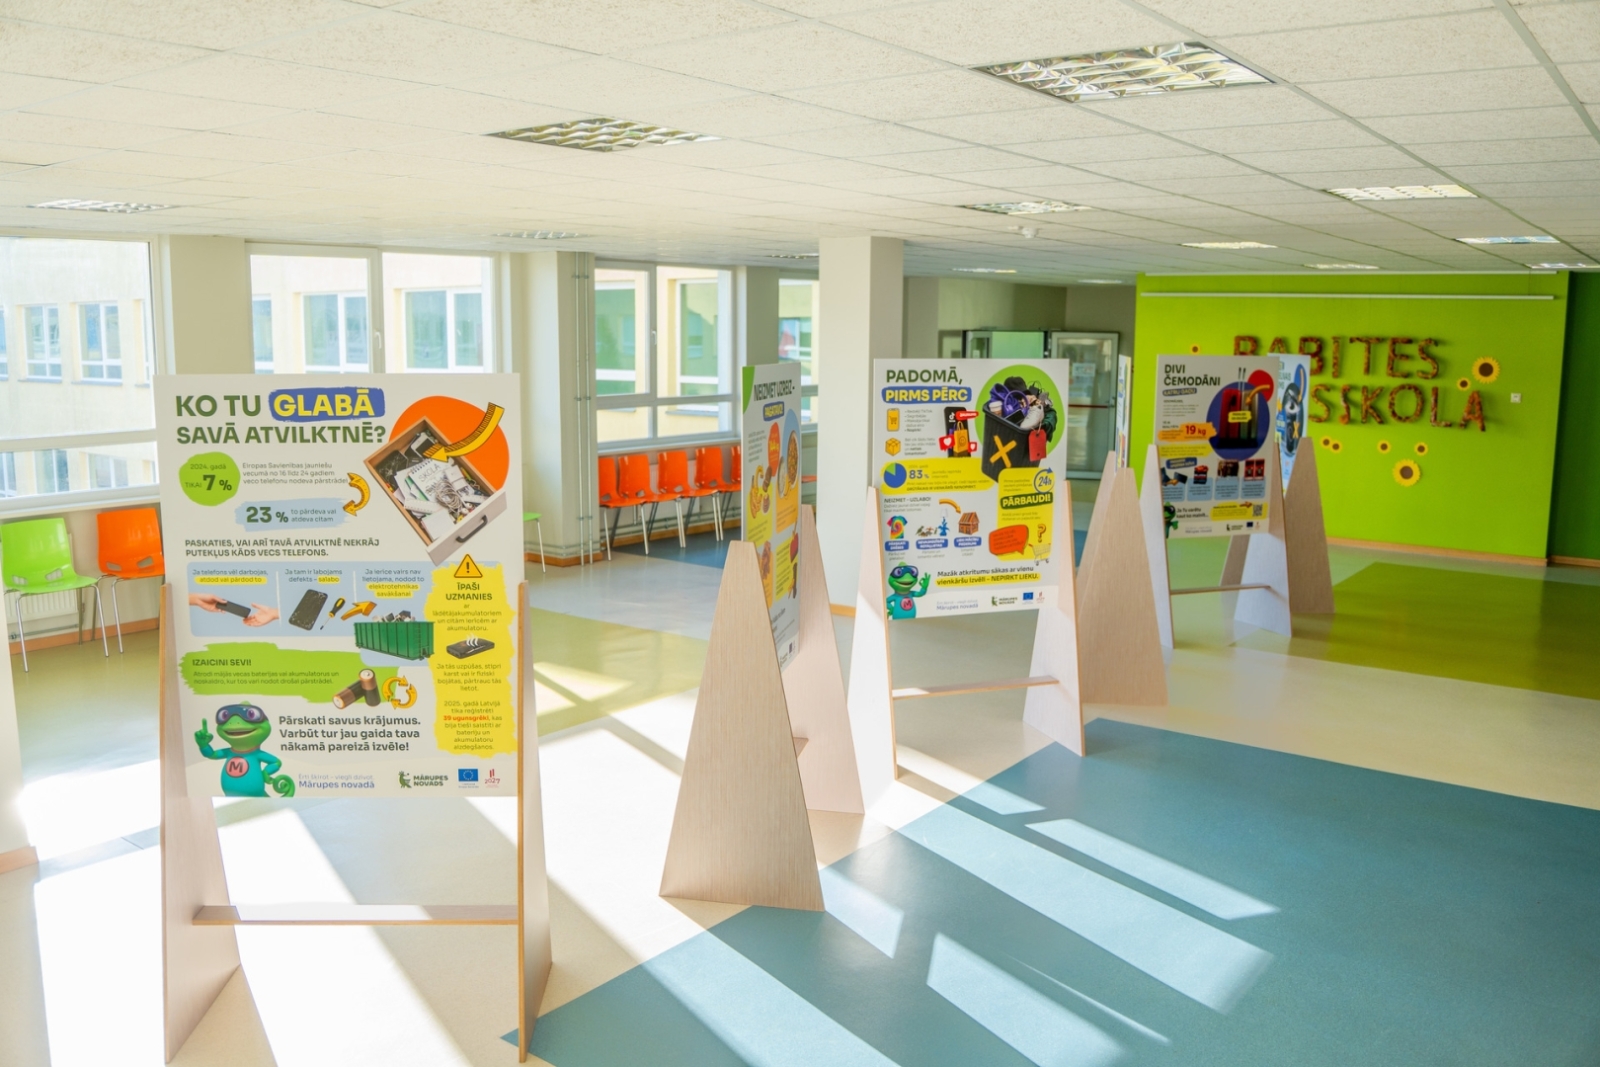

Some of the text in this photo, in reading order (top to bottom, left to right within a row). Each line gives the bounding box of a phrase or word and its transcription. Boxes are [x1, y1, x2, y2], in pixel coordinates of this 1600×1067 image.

[1165, 364, 1185, 374] DIVI
[886, 366, 963, 385] PADOMĀ,
[1164, 374, 1220, 386] ČEMODĀNI
[886, 387, 968, 401] PIRMS PĒRC
[176, 389, 375, 417] KO TU GLABĀ
[177, 422, 386, 444] SAVĀ ATVILKTNĒ?
[1186, 425, 1196, 435] 19
[1198, 427, 1206, 435] kg
[909, 470, 923, 479] 83
[203, 475, 215, 491] 7
[219, 480, 232, 491] %
[1038, 476, 1051, 487] 24h
[1003, 494, 1051, 507] PĀRBAUDI!
[246, 507, 289, 523] 23 %
[300, 508, 326, 516] pārdeva
[185, 539, 234, 548] PASKATIES,
[252, 537, 268, 546] ARĪ
[269, 537, 292, 546] TAVĀ
[294, 537, 341, 546] ATVILKTNĒ
[343, 537, 380, 546] NEKRĀJ
[186, 549, 229, 558] PUTEKĻUS
[231, 547, 256, 556] KĀDS
[936, 577, 968, 585] vienkāršu
[991, 574, 1018, 582] NEPIRKT
[457, 582, 479, 590] ĪPAŠI
[903, 600, 912, 608] M
[279, 715, 421, 727] Pārskati savus krājumus.
[280, 729, 420, 740] Varbūt tur jau gaida tava
[281, 742, 409, 753] nākamā pareizā izvēle!
[228, 761, 243, 772] M
[299, 780, 375, 790] Mārupes novadā
